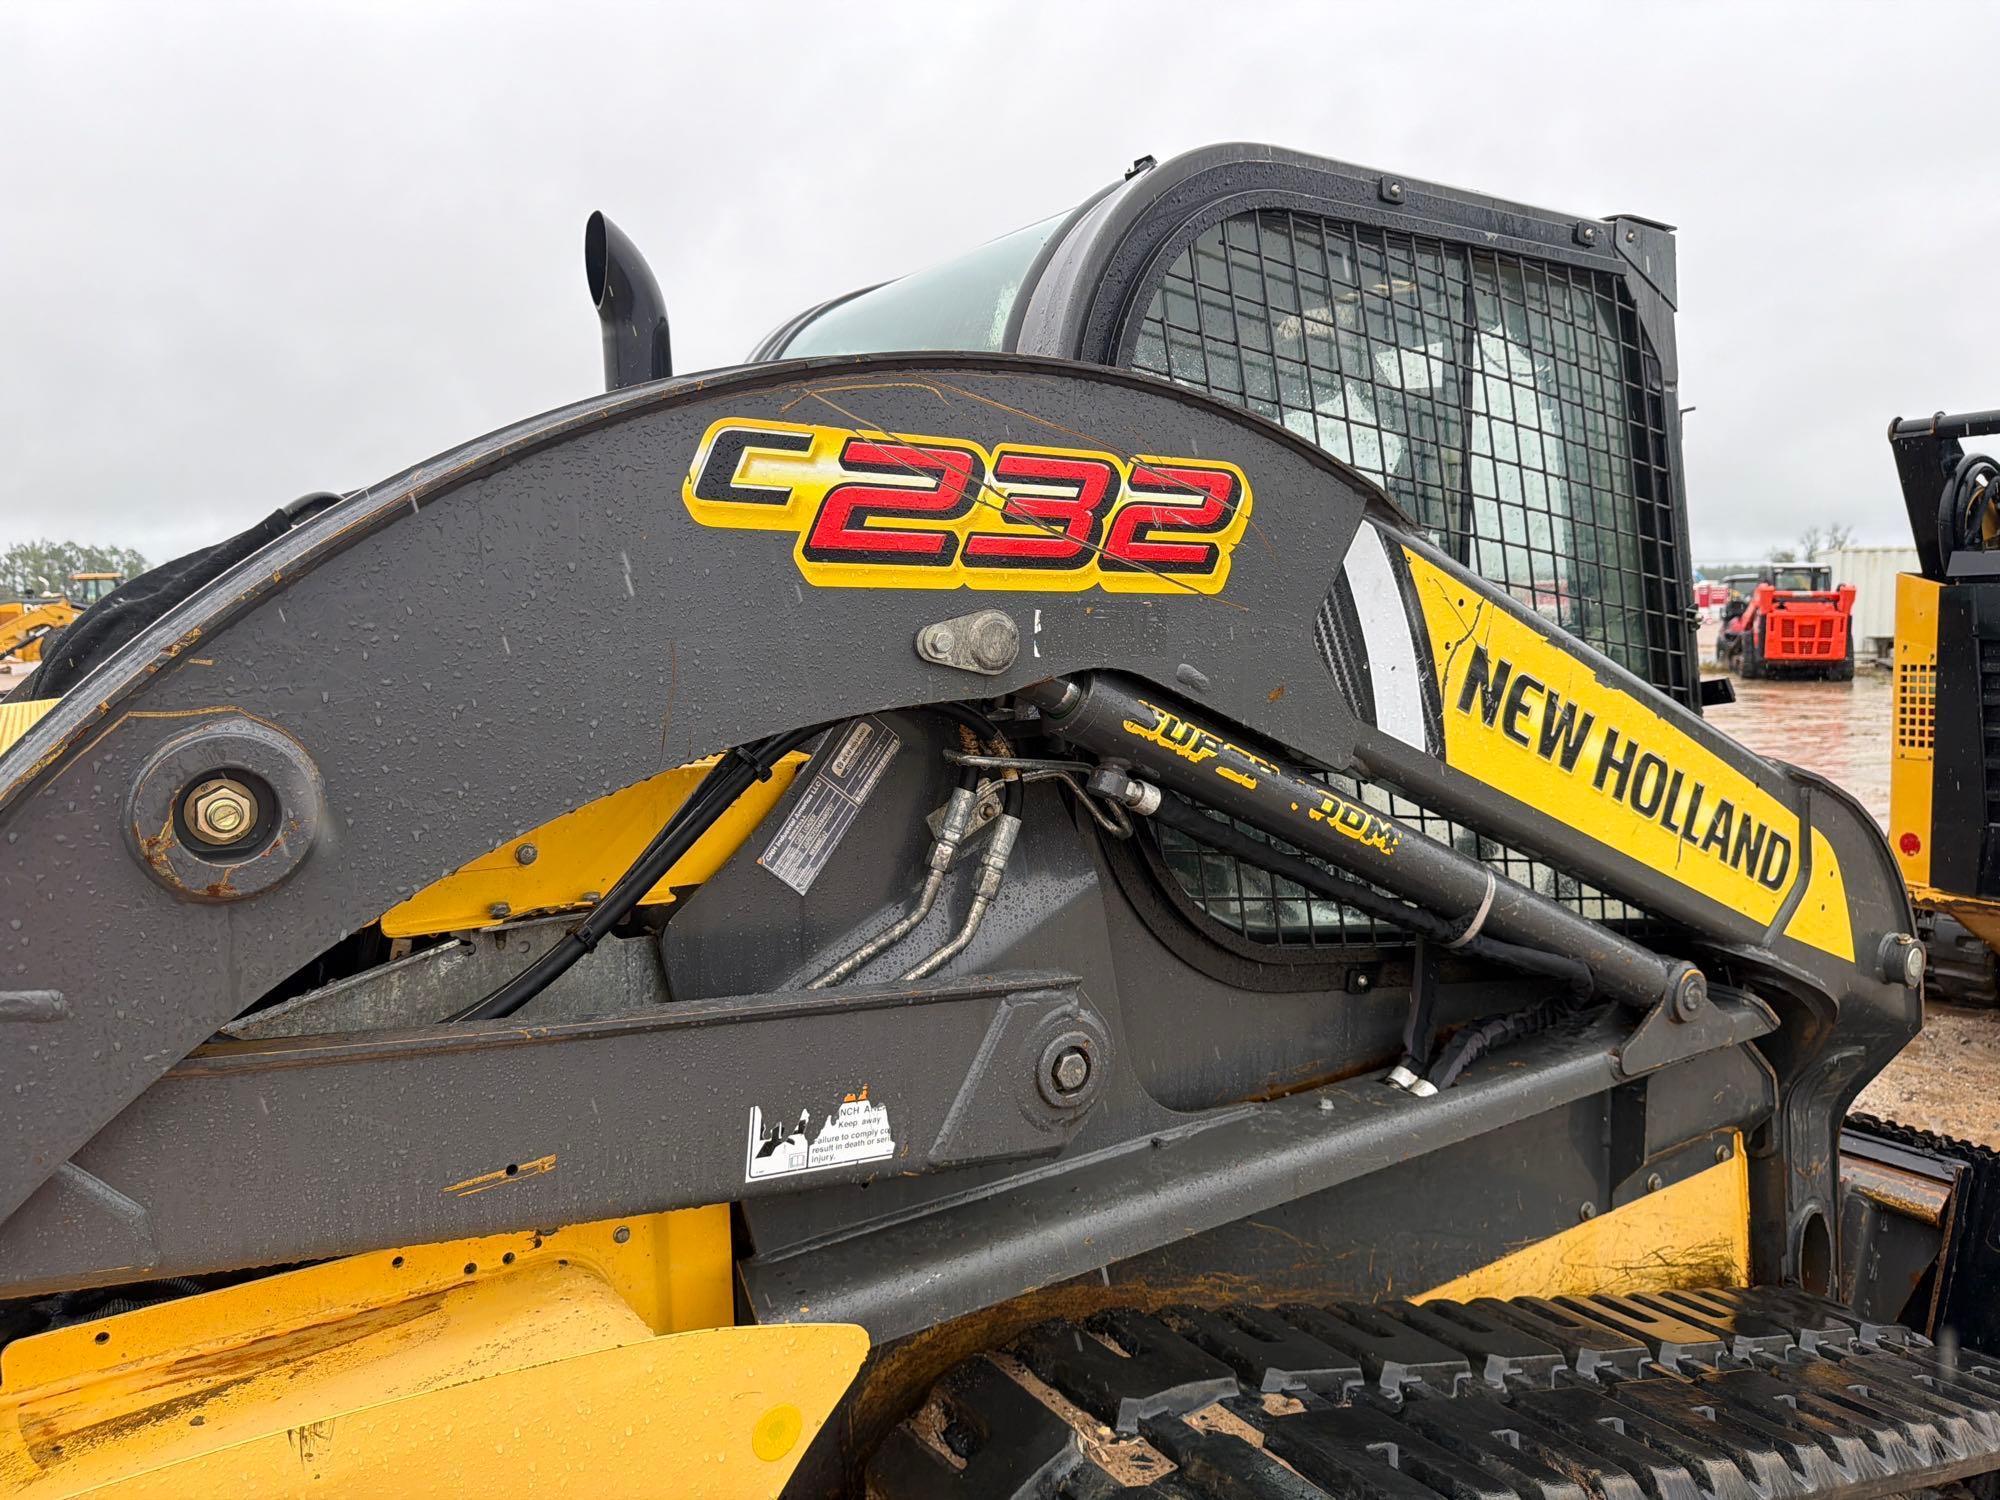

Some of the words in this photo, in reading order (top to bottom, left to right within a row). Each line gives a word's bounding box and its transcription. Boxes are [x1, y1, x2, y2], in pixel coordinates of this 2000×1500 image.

[692, 424, 1242, 575] C232
[1457, 645, 1595, 773] NEW
[1593, 727, 1791, 890] HOLLAND
[765, 845, 778, 861] CNH
[775, 817, 797, 846] Industrial
[793, 793, 813, 819] America
[810, 780, 822, 794] LLC
[838, 1120, 858, 1128] Keep
[862, 1117, 881, 1125] away
[816, 1136, 839, 1144] ailure
[841, 1133, 849, 1141] to
[851, 1129, 878, 1139] comply
[812, 1144, 834, 1154] result
[836, 1142, 843, 1150] in
[844, 1139, 865, 1149] death
[811, 1153, 836, 1164] injury.
